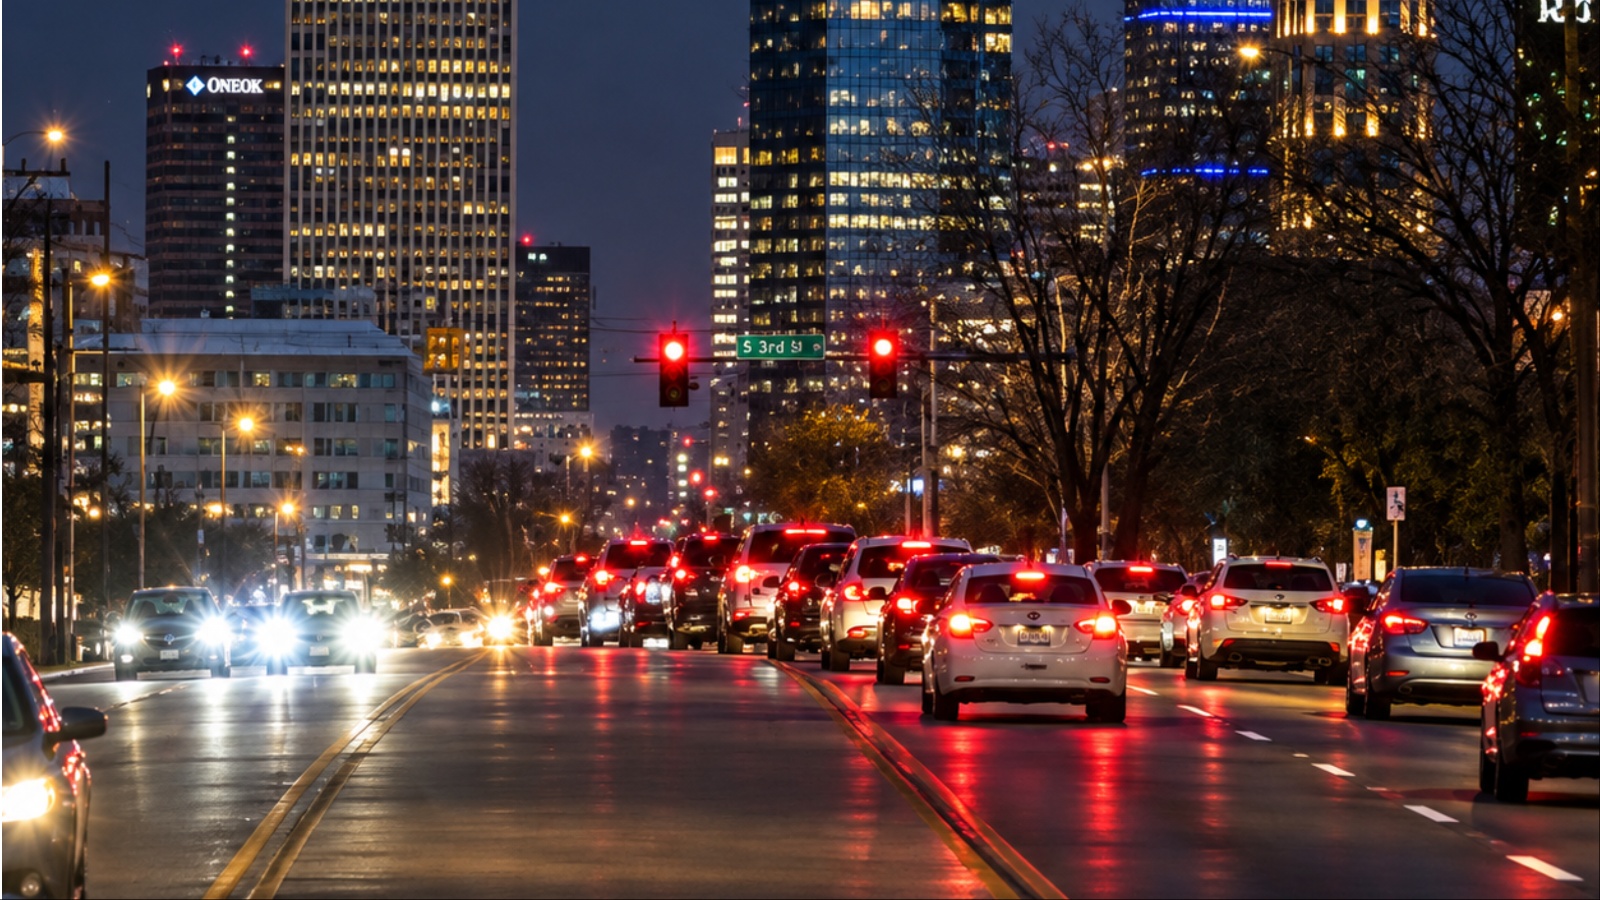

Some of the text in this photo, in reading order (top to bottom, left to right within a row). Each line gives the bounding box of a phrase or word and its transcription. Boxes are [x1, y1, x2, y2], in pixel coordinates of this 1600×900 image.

[207, 76, 264, 93] ONEOK
[743, 340, 752, 353] S
[759, 340, 784, 353] 3rd
